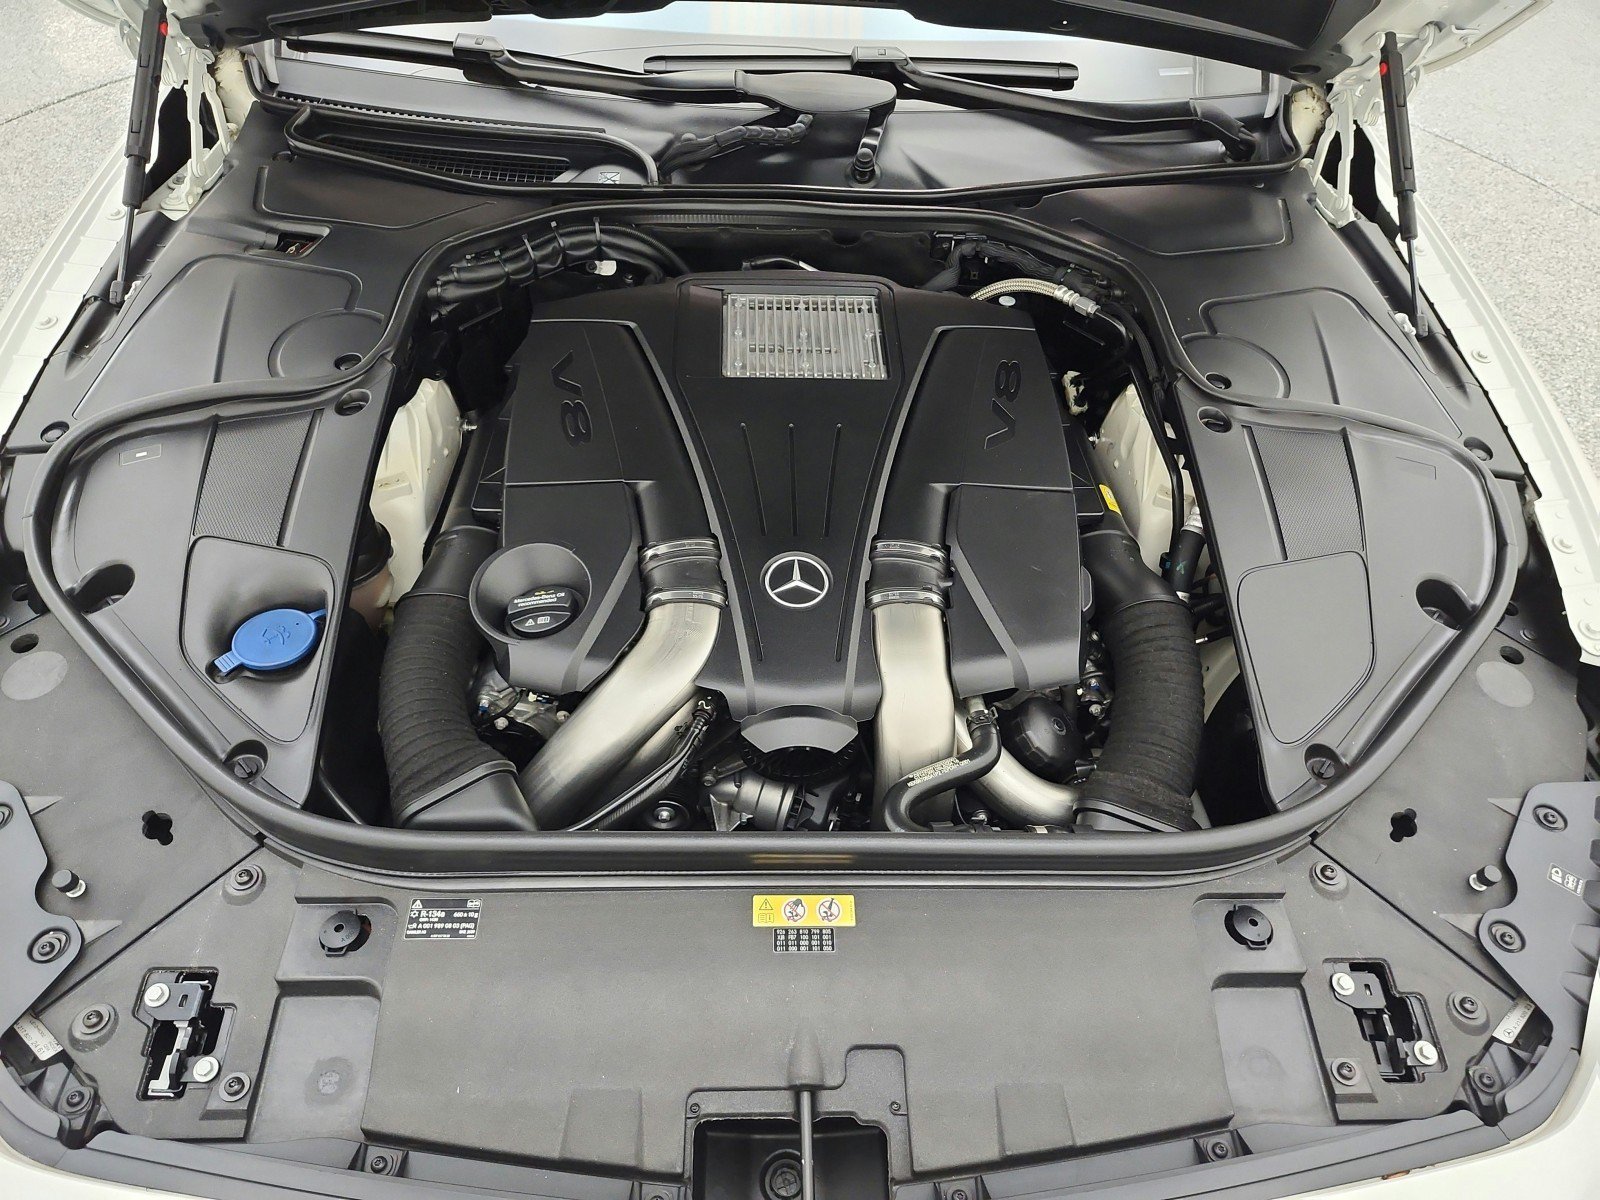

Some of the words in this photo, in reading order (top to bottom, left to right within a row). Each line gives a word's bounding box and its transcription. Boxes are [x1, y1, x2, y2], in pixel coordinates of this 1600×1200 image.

[550, 347, 592, 448] V8
[984, 360, 1022, 450] V8
[514, 594, 556, 603] Mercedes-Benz
[518, 598, 557, 606] recommended
